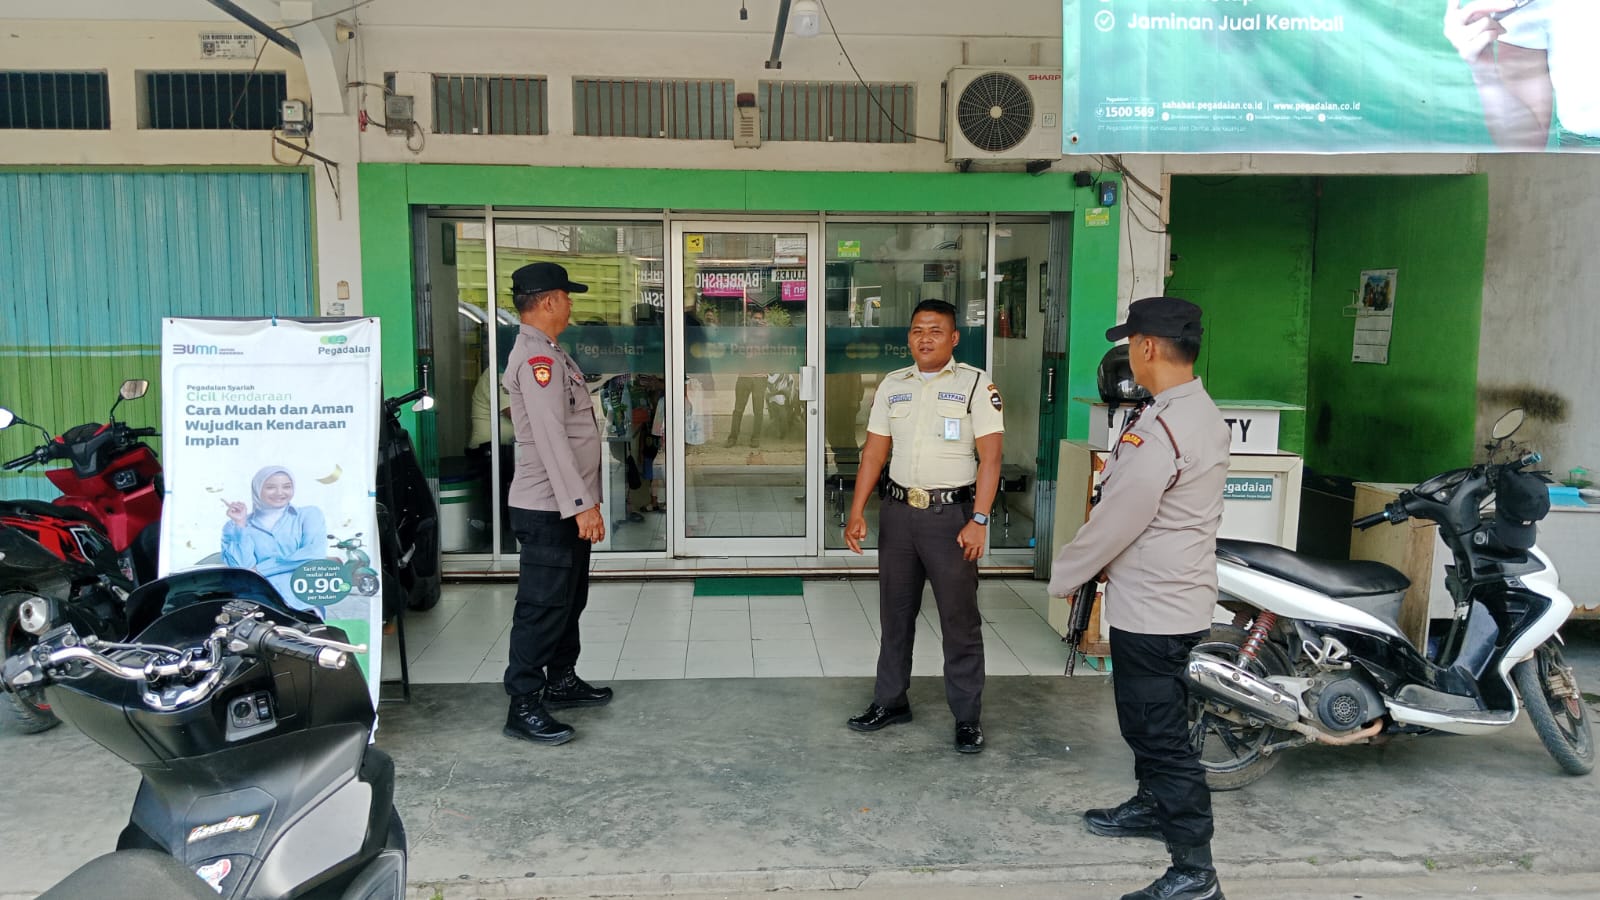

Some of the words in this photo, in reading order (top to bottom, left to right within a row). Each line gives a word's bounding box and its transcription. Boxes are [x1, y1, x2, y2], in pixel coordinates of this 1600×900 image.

[1127, 12, 1213, 31] Jaminan
[1218, 13, 1260, 32] Jual
[1265, 13, 1345, 32] Kembali
[1105, 106, 1133, 118] 1500
[1273, 101, 1361, 112] www.pegadaian.co.id
[318, 345, 371, 356] Pegadaian
[575, 343, 645, 358] Pegadaian
[730, 343, 797, 358] Pegadaian
[186, 384, 226, 392] Pegadaian
[227, 384, 255, 392] Syariah
[186, 391, 217, 402] Cicil
[221, 391, 292, 402] Kendaraan
[185, 404, 221, 416] Cara
[224, 403, 276, 416] Mudah
[279, 403, 308, 415] dan
[311, 404, 354, 415] Aman
[185, 420, 263, 433] Wujudkan
[266, 419, 347, 431] Kendaraan
[185, 435, 240, 448] Impian
[1223, 481, 1272, 494] egadaian
[293, 577, 344, 594] 0.90
